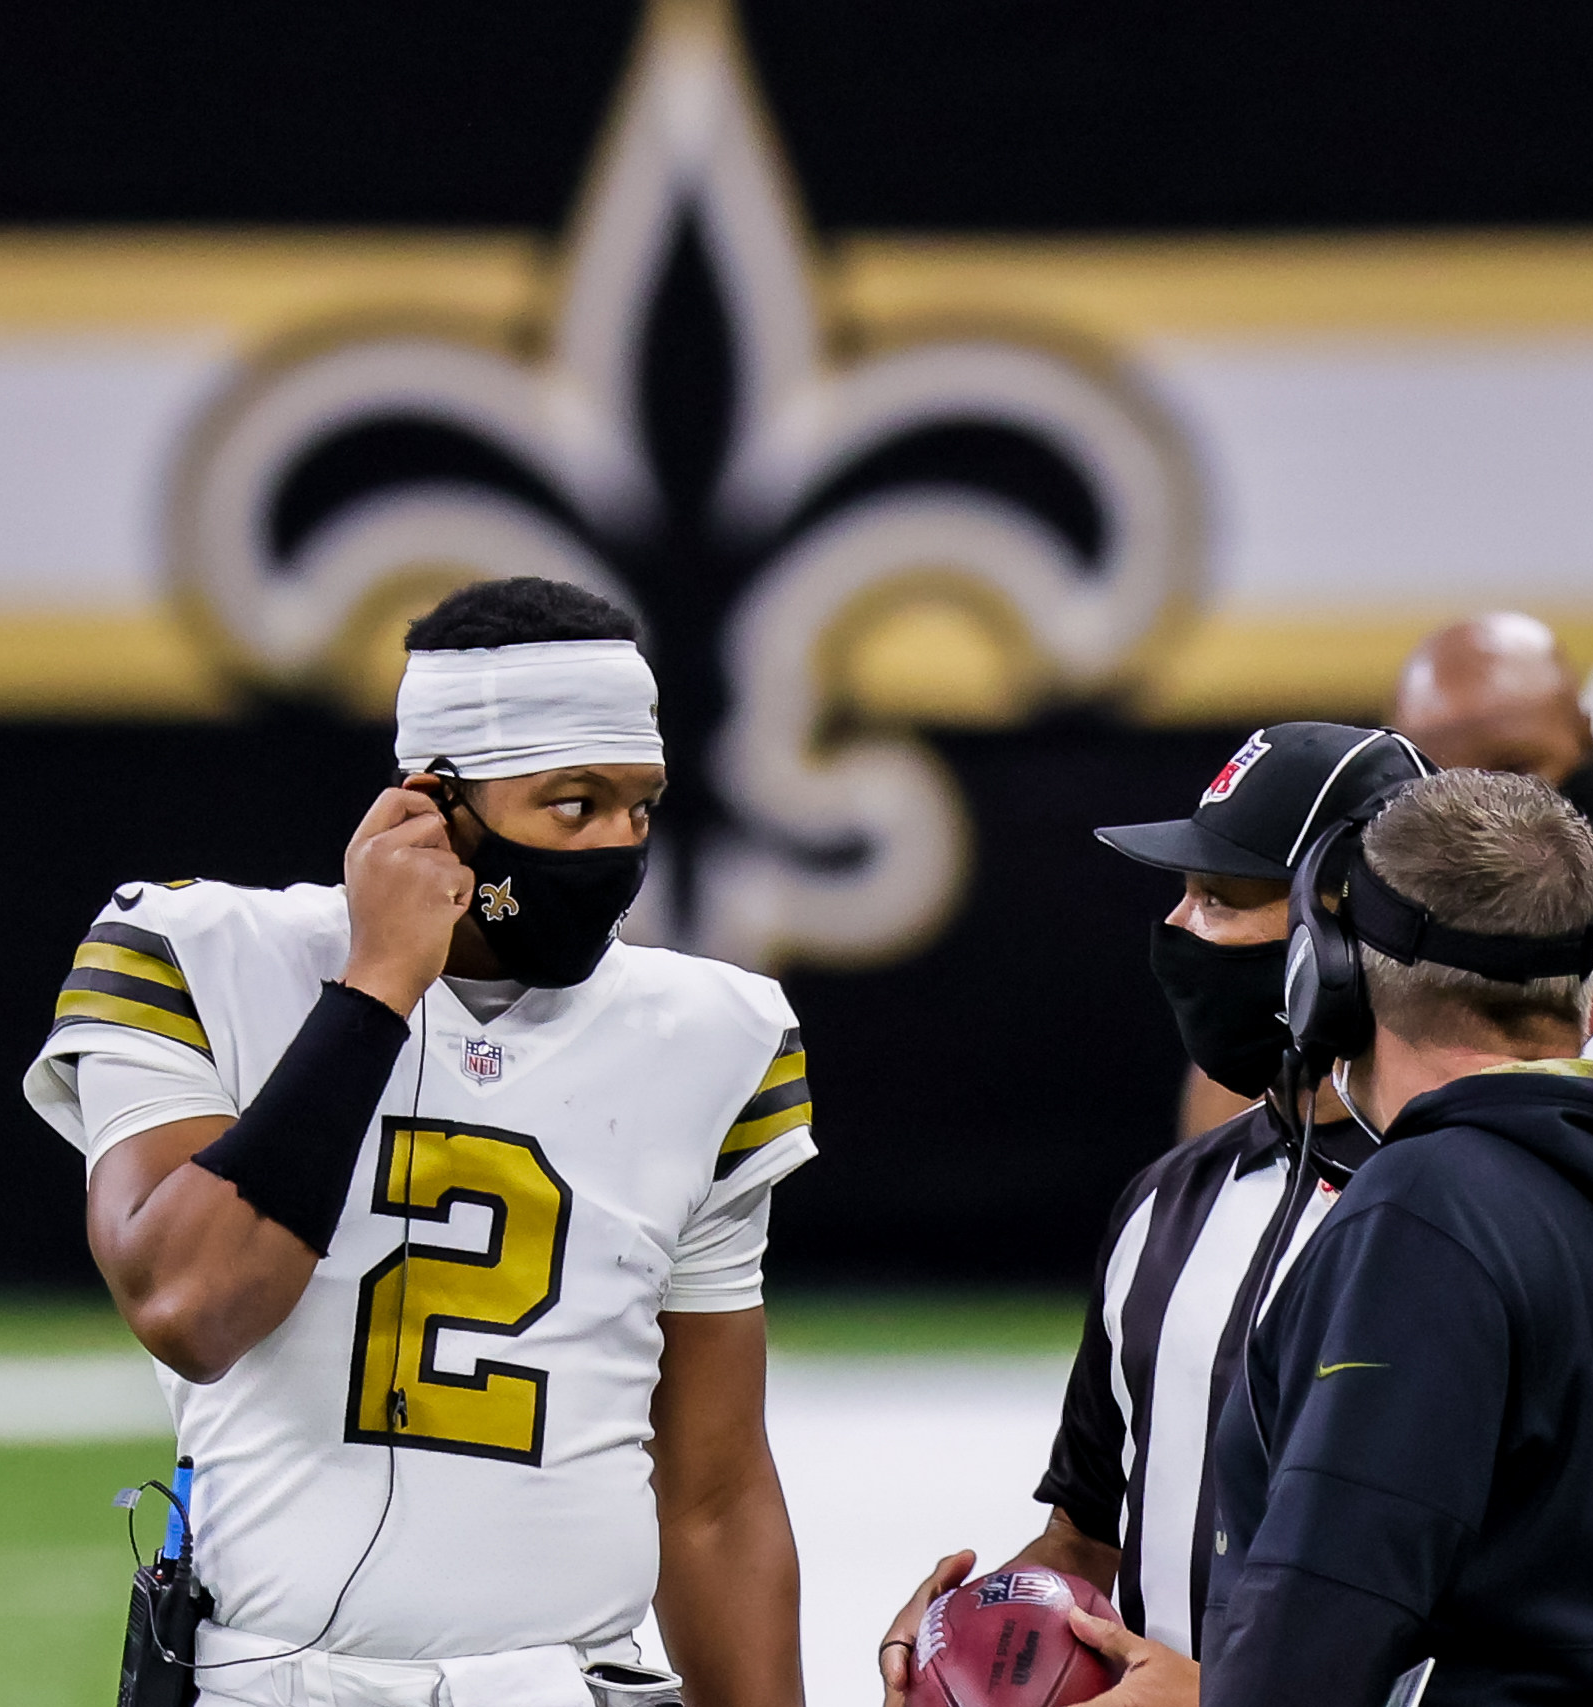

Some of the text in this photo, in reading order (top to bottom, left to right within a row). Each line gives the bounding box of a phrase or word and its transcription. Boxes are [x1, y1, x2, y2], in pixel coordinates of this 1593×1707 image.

[468, 1056, 497, 1075] NFL
[344, 1115, 573, 1467] 2
[1010, 1574, 1053, 1602] NFL
